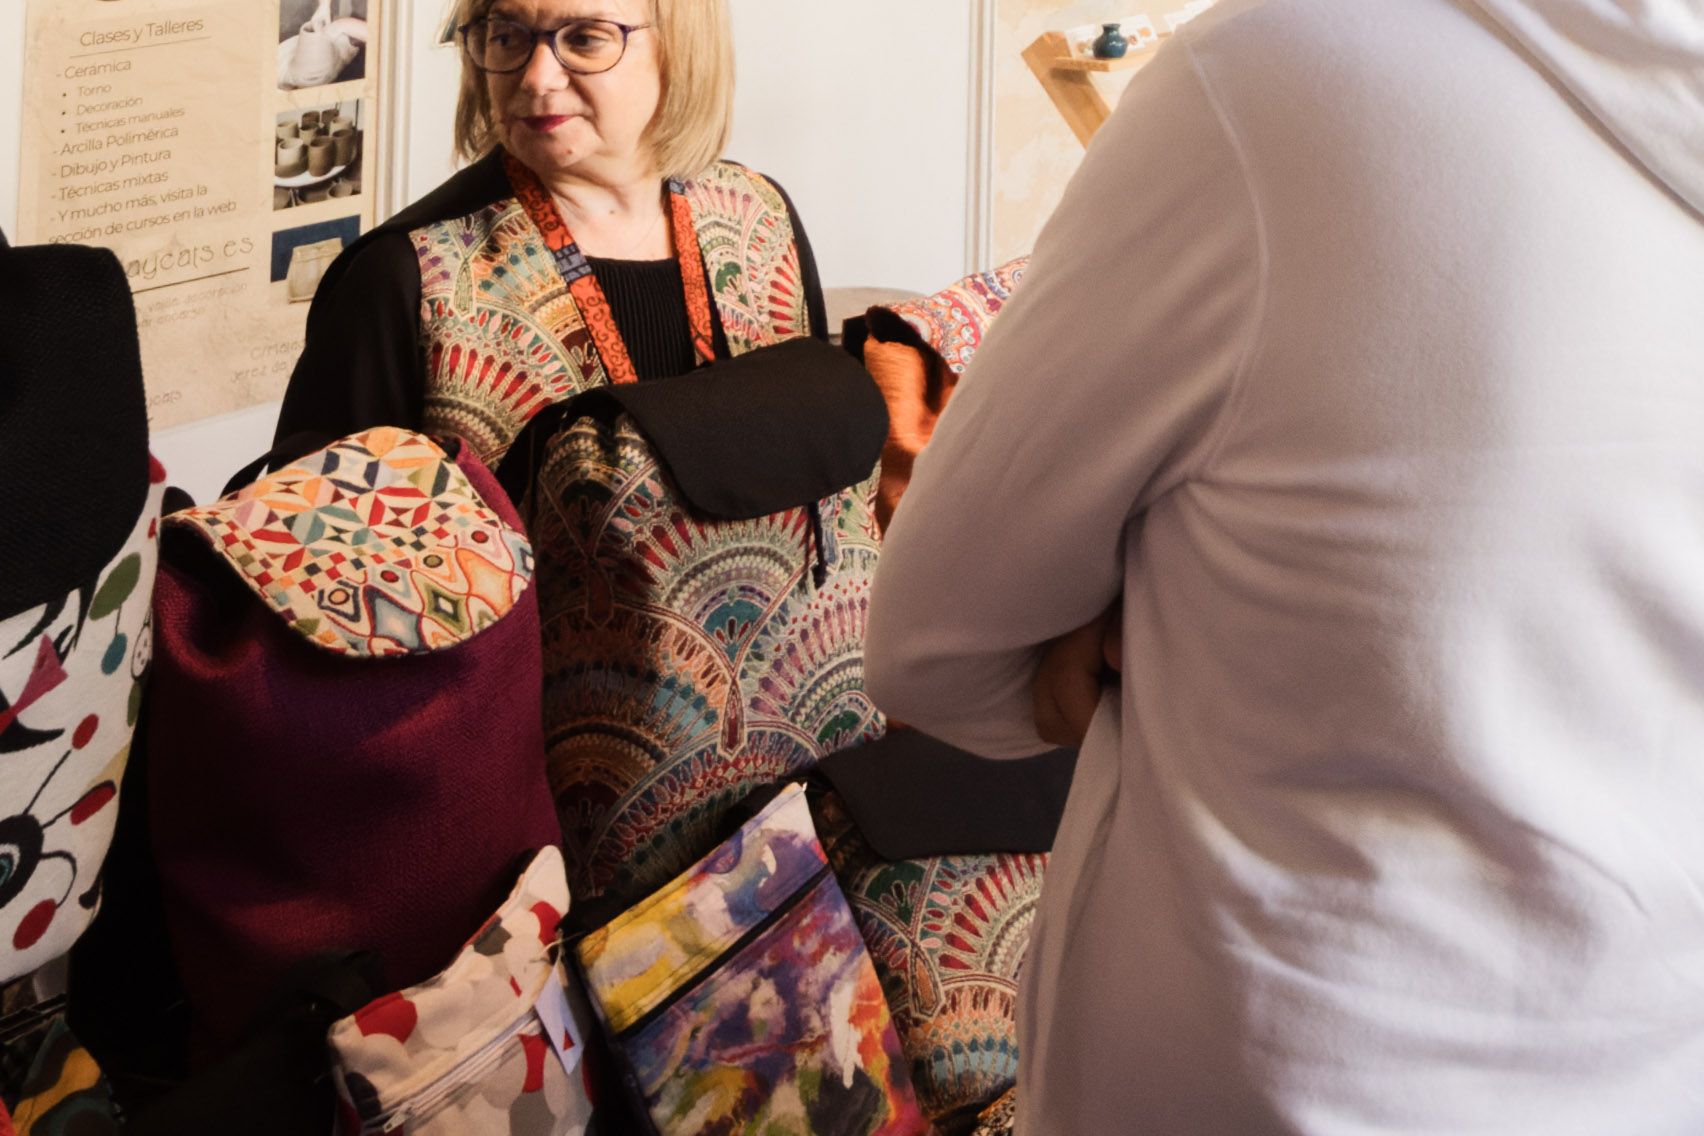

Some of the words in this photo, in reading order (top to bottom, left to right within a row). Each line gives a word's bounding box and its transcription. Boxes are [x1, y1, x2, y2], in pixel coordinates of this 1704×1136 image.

[80, 29, 131, 47] Clases
[132, 27, 144, 44] y
[145, 17, 205, 37] Talleres
[60, 138, 103, 156] Arcilla
[60, 160, 107, 178] Dibujo
[108, 158, 119, 172] y
[121, 149, 172, 167] Pintura
[123, 170, 169, 189] mixtas
[57, 209, 70, 222] Y
[70, 200, 123, 220] mucho
[160, 187, 194, 204] visita
[197, 184, 208, 197] la
[104, 221, 123, 235] de
[126, 214, 170, 230] cursos
[172, 210, 191, 223] en
[193, 206, 204, 218] la
[207, 199, 237, 216] web
[124, 246, 215, 279] aycats
